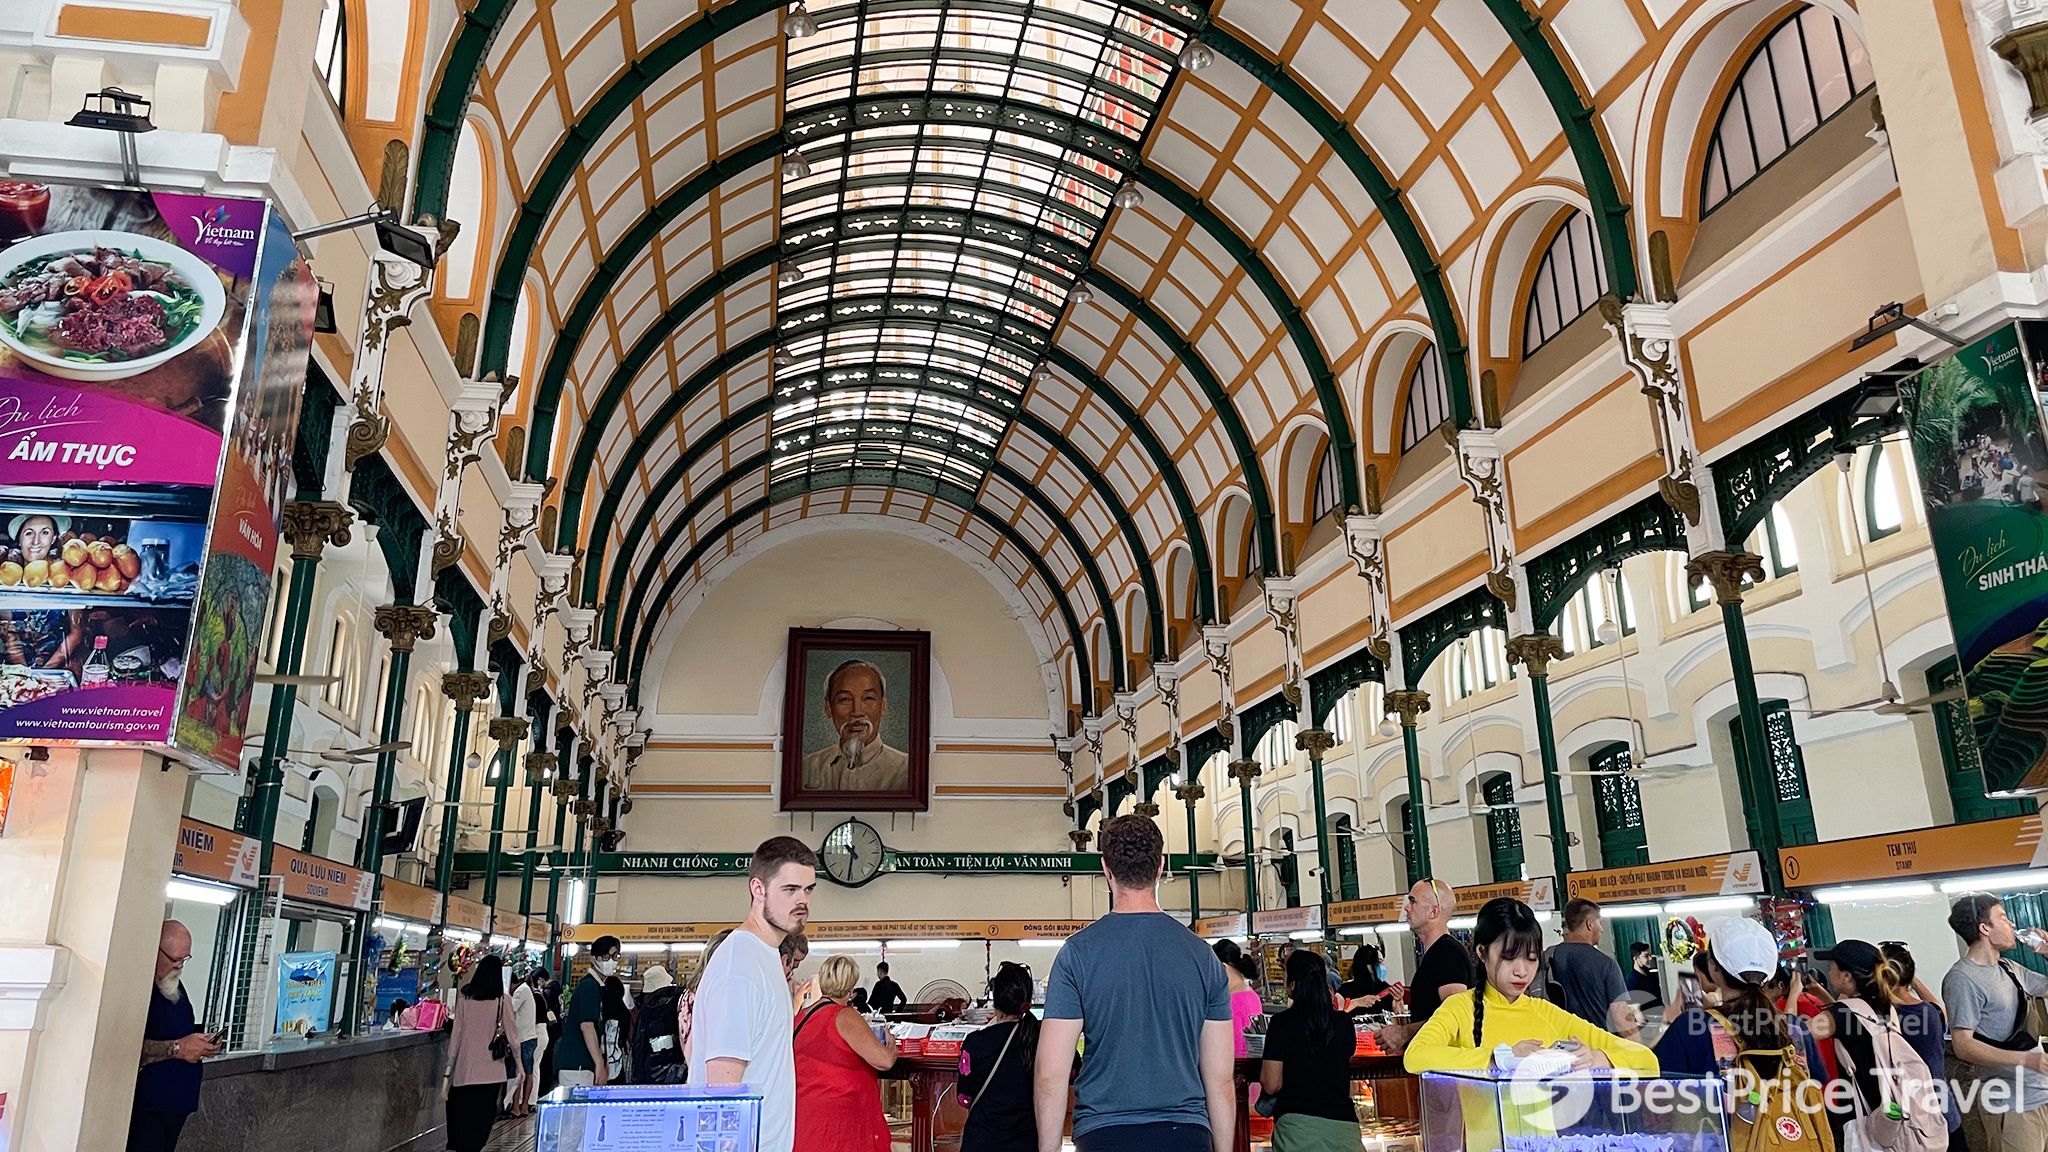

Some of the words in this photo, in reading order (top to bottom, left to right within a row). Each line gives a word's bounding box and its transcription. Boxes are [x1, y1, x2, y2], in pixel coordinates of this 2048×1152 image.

[190, 215, 255, 245] Vietnam
[1980, 346, 2019, 376] Vietnam
[38, 393, 83, 424] lịch
[8, 431, 58, 462] ẨM
[61, 443, 137, 470] THỰC
[1958, 546, 1982, 576] Du
[1978, 566, 2014, 591] SINH
[2015, 551, 2048, 579] THÁ
[61, 705, 164, 717] www.vietnam.travel
[16, 719, 160, 733] www.vietnamtourism.gov.vn
[181, 828, 214, 854] NIỆM
[1886, 843, 1902, 858] TEM
[622, 857, 668, 868] NHANH
[672, 854, 718, 868] CHÓNG
[912, 855, 946, 868] TOÀN
[954, 854, 983, 870] TIỆN
[985, 855, 1004, 870] LỢI
[1014, 854, 1039, 868] VĂN
[1041, 857, 1072, 868] MINH
[1896, 860, 1913, 870] STAMP
